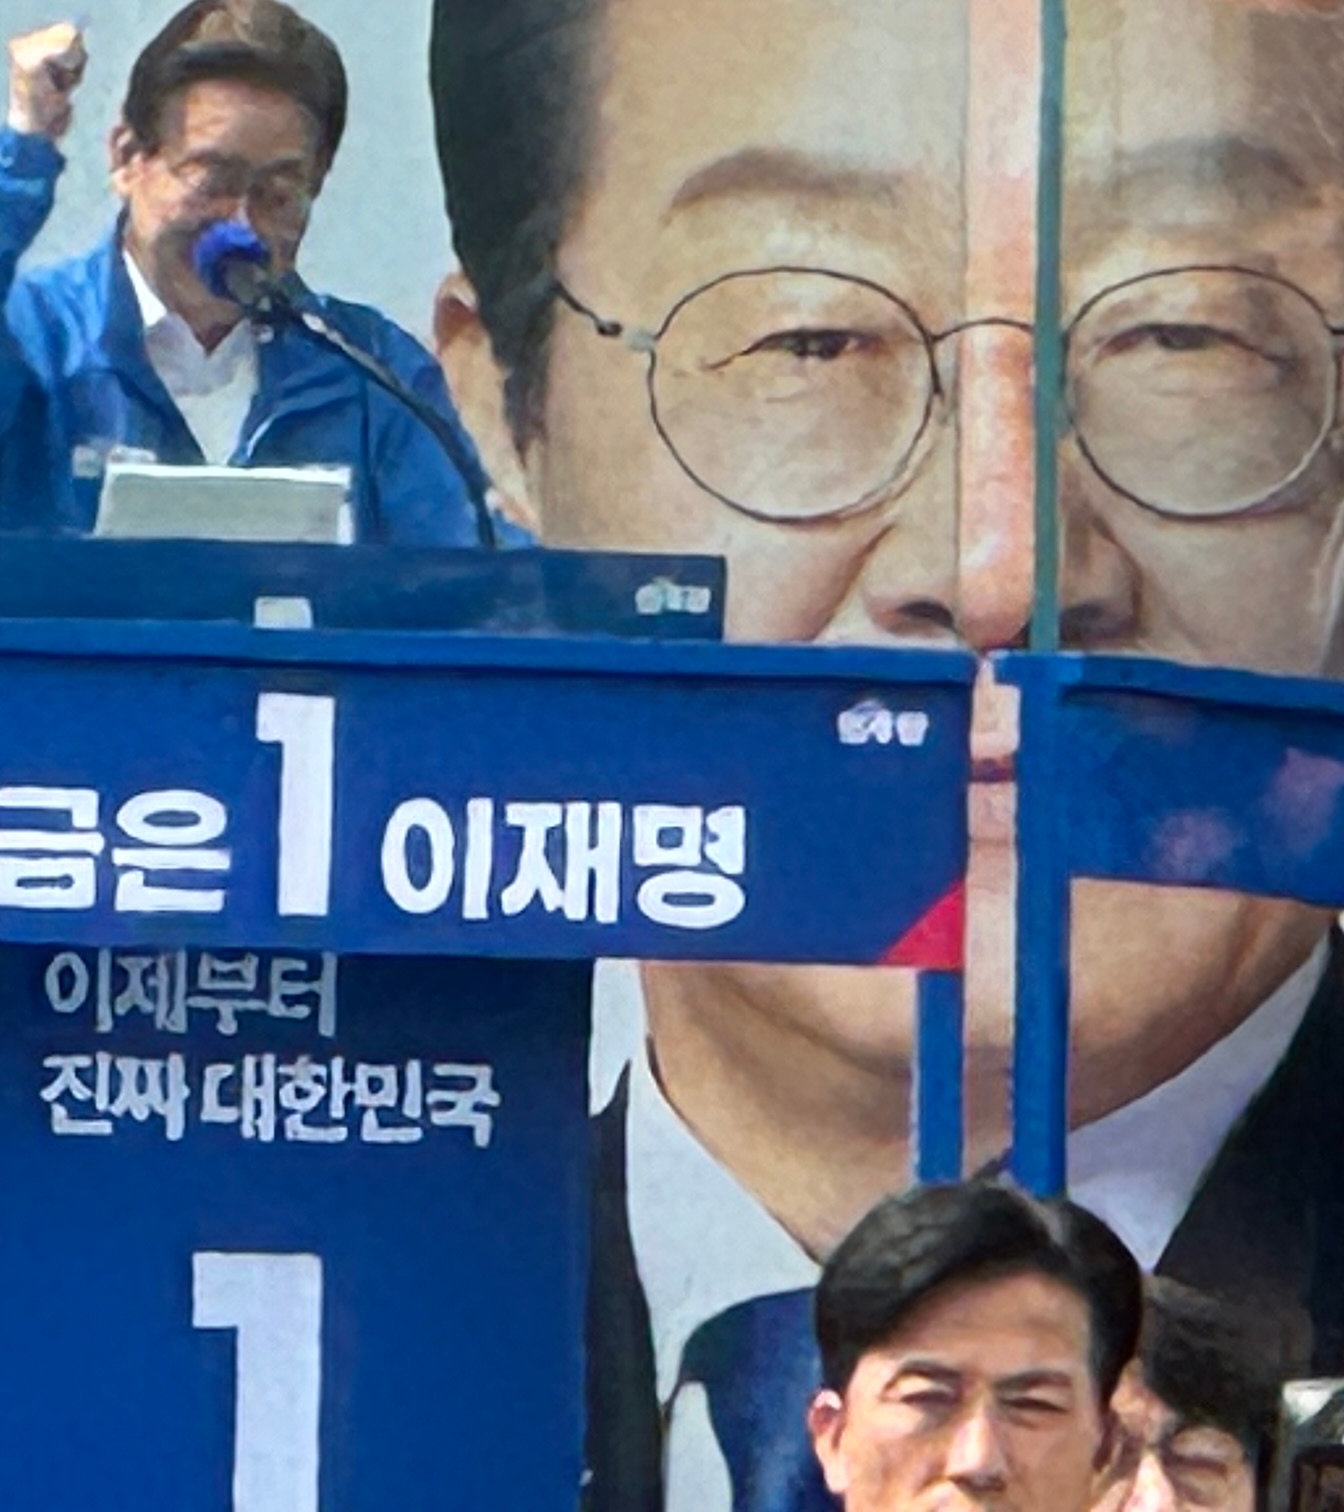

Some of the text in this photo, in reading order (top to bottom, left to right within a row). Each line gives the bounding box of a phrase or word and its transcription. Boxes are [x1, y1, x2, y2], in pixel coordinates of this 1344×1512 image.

[256, 692, 335, 916] 1
[381, 797, 746, 929] 이재명
[45, 948, 337, 1037] 이제부터
[40, 1051, 501, 1148] 진짜 대한민국
[192, 1252, 322, 1512] 1
